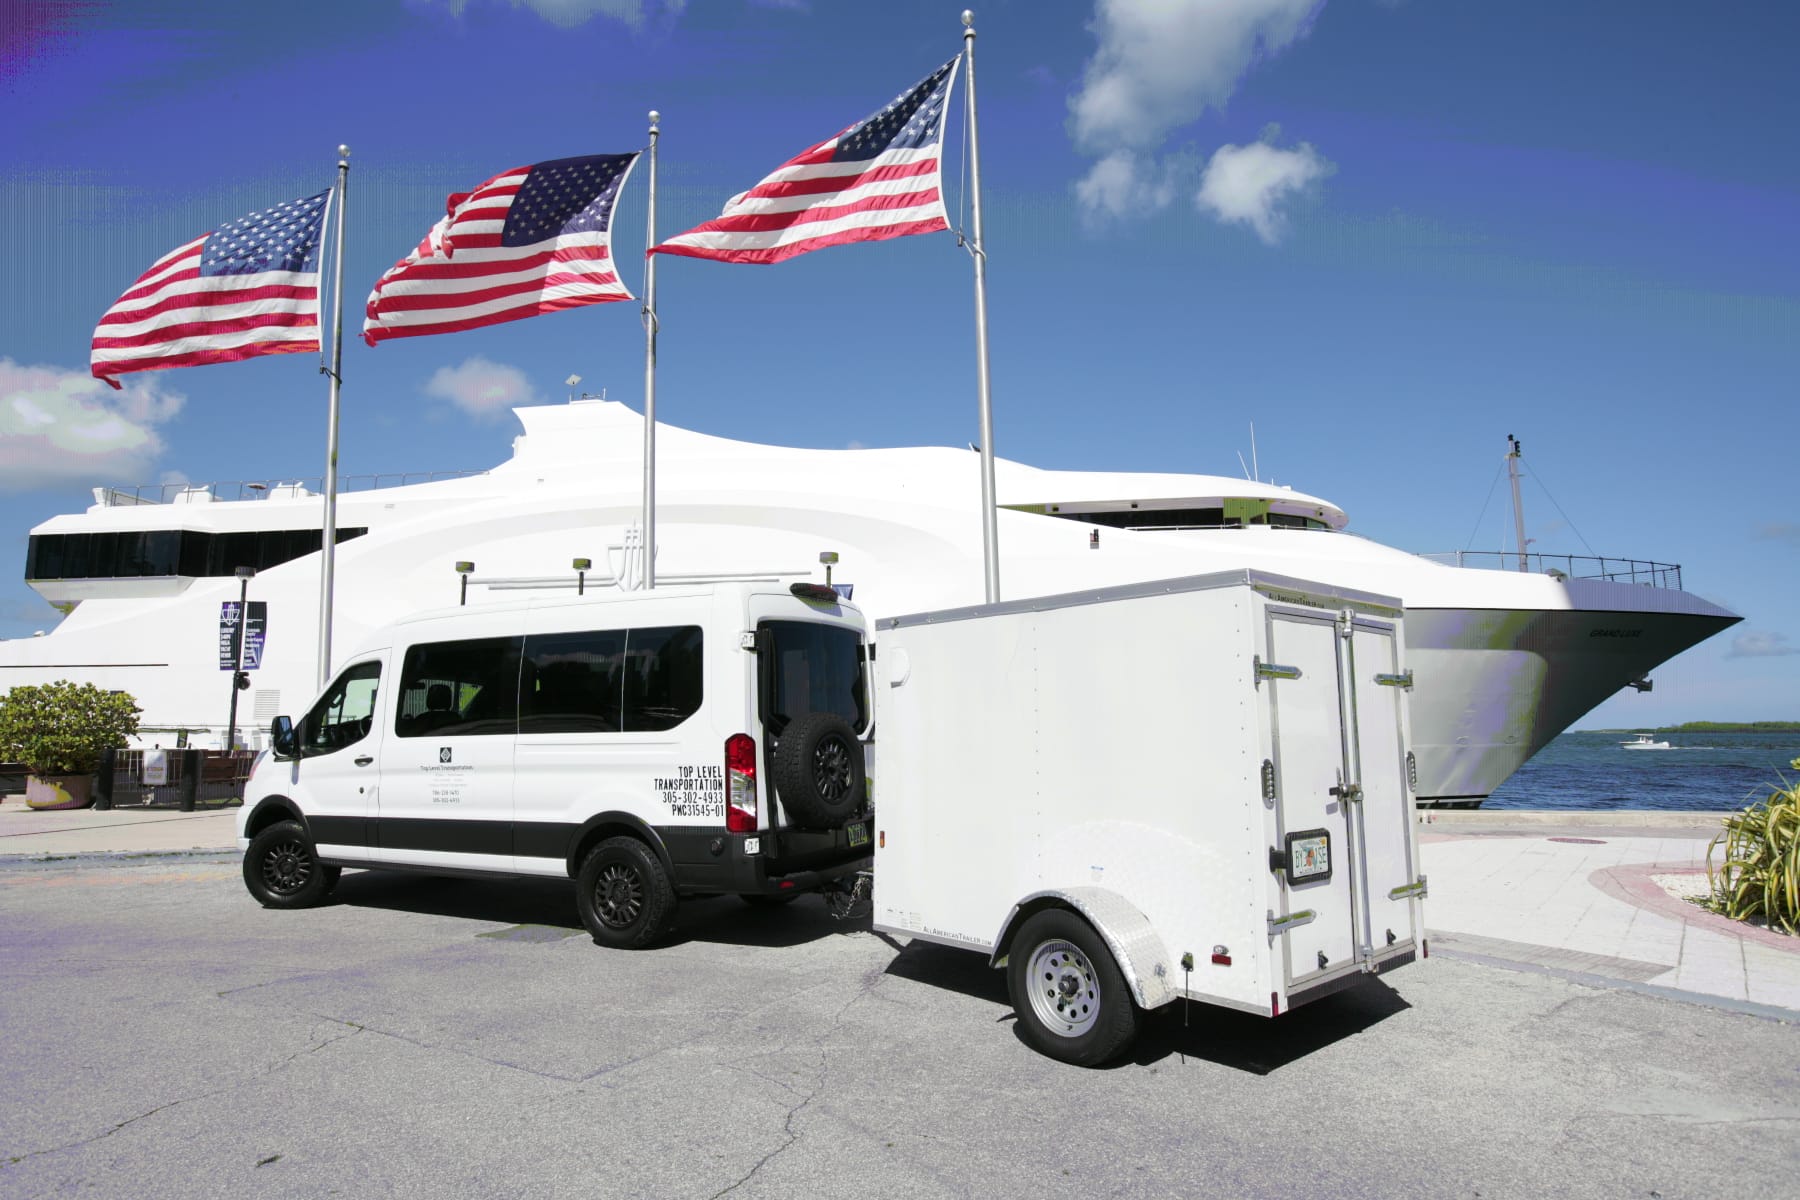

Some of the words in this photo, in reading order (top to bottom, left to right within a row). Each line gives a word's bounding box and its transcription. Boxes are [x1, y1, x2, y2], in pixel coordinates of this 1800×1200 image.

[678, 766, 694, 778] TOP
[697, 766, 722, 778] LEVEL
[654, 778, 723, 791] TRANSPORTATION
[663, 791, 723, 804] 305-302-4933
[672, 804, 724, 817] PMC31545-01
